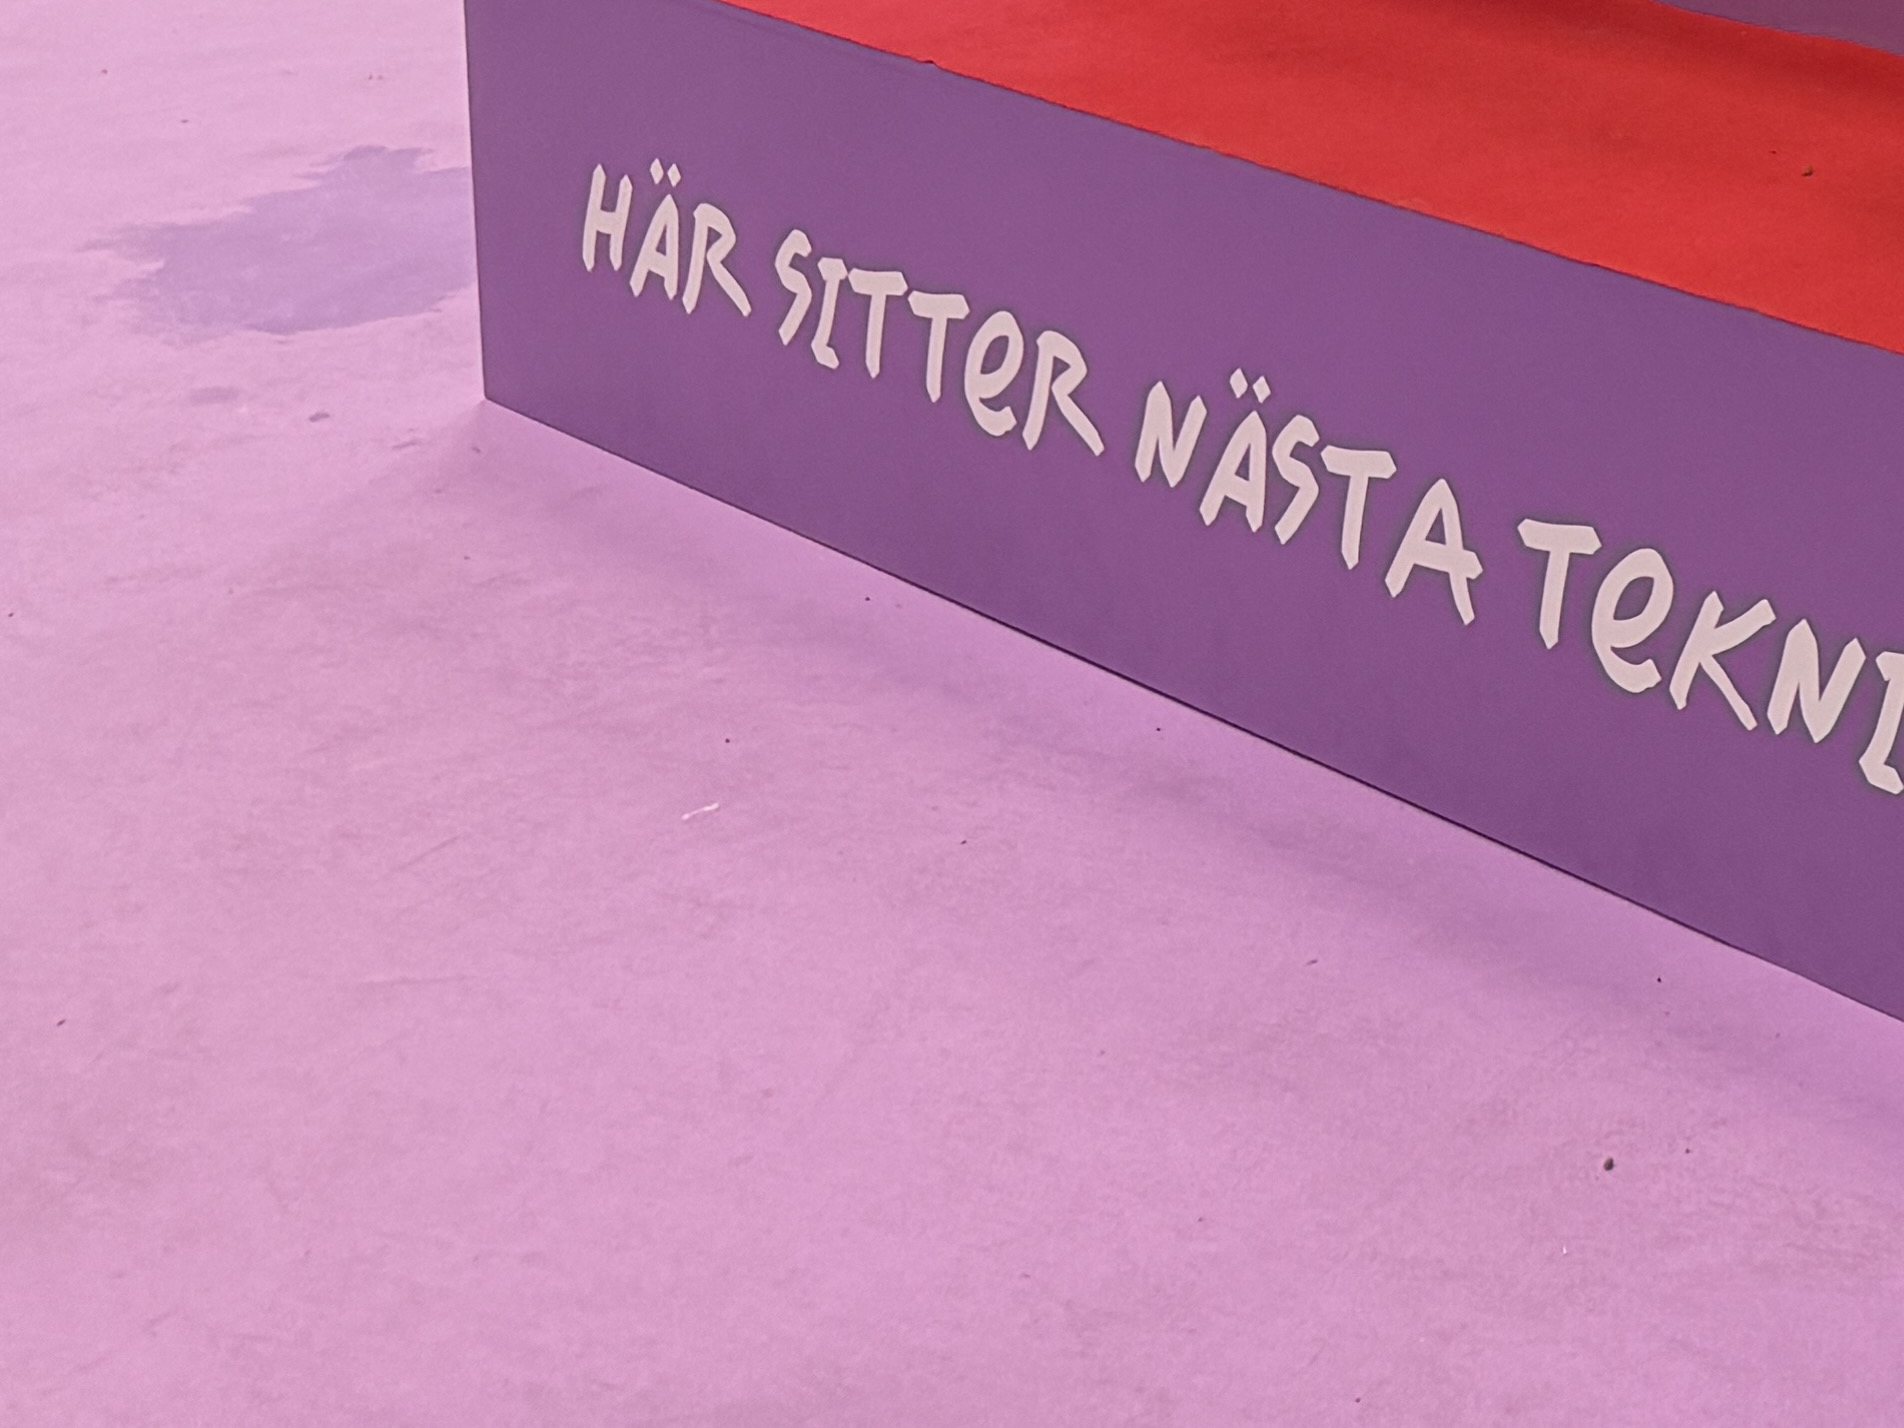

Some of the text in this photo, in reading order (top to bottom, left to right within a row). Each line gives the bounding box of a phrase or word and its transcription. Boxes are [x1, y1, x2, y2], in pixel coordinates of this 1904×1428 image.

[582, 158, 752, 318] HÄR
[775, 228, 1105, 456] SITTER
[1134, 368, 1483, 626] NÄSTA
